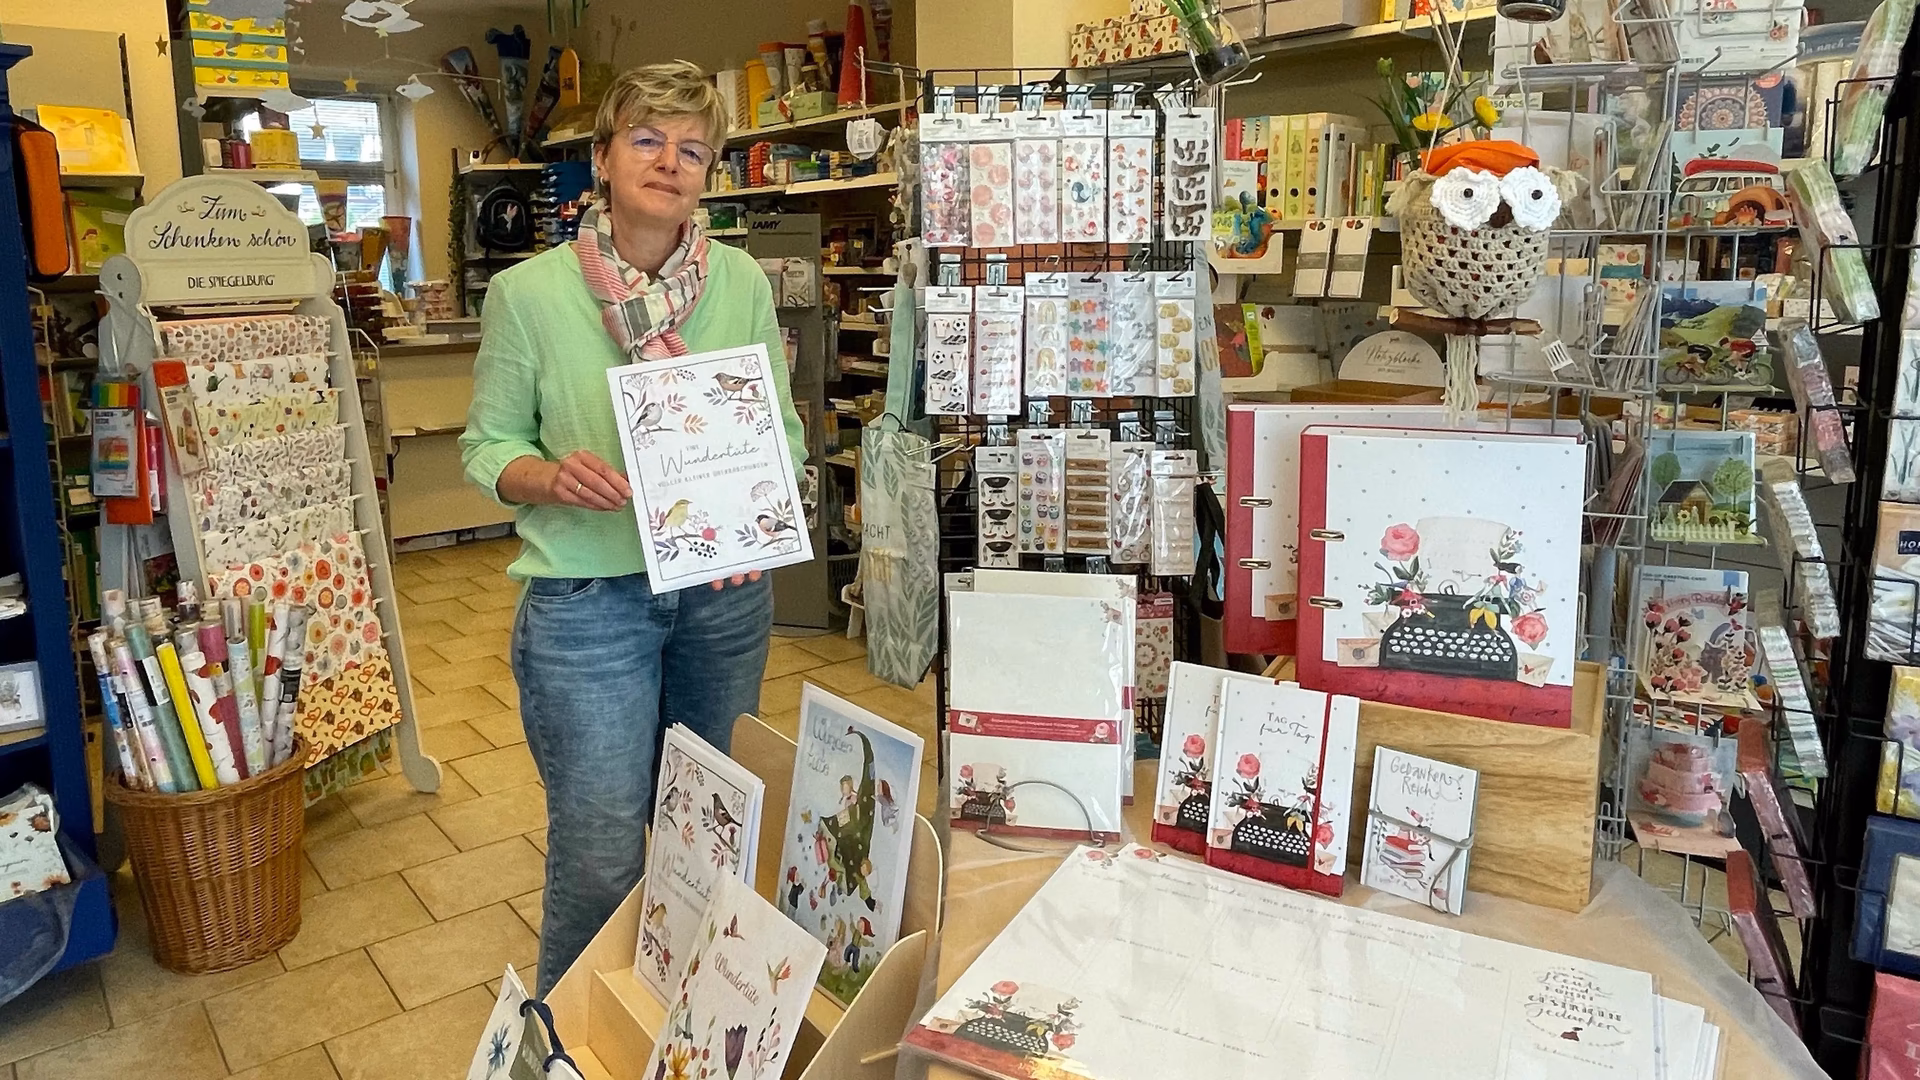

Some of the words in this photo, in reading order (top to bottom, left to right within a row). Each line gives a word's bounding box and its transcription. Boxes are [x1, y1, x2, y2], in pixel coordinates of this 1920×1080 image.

[198, 195, 247, 221] Zum
[149, 221, 241, 249] Schenken
[247, 228, 296, 247] schön
[752, 220, 781, 230] LAMY
[187, 276, 206, 289] DIE
[208, 274, 275, 289] SPIEGELBURG
[660, 440, 760, 477] Wundertüte
[1267, 711, 1288, 724] TAG
[1289, 722, 1315, 744] Tag
[714, 951, 761, 1006] Wundertüte
